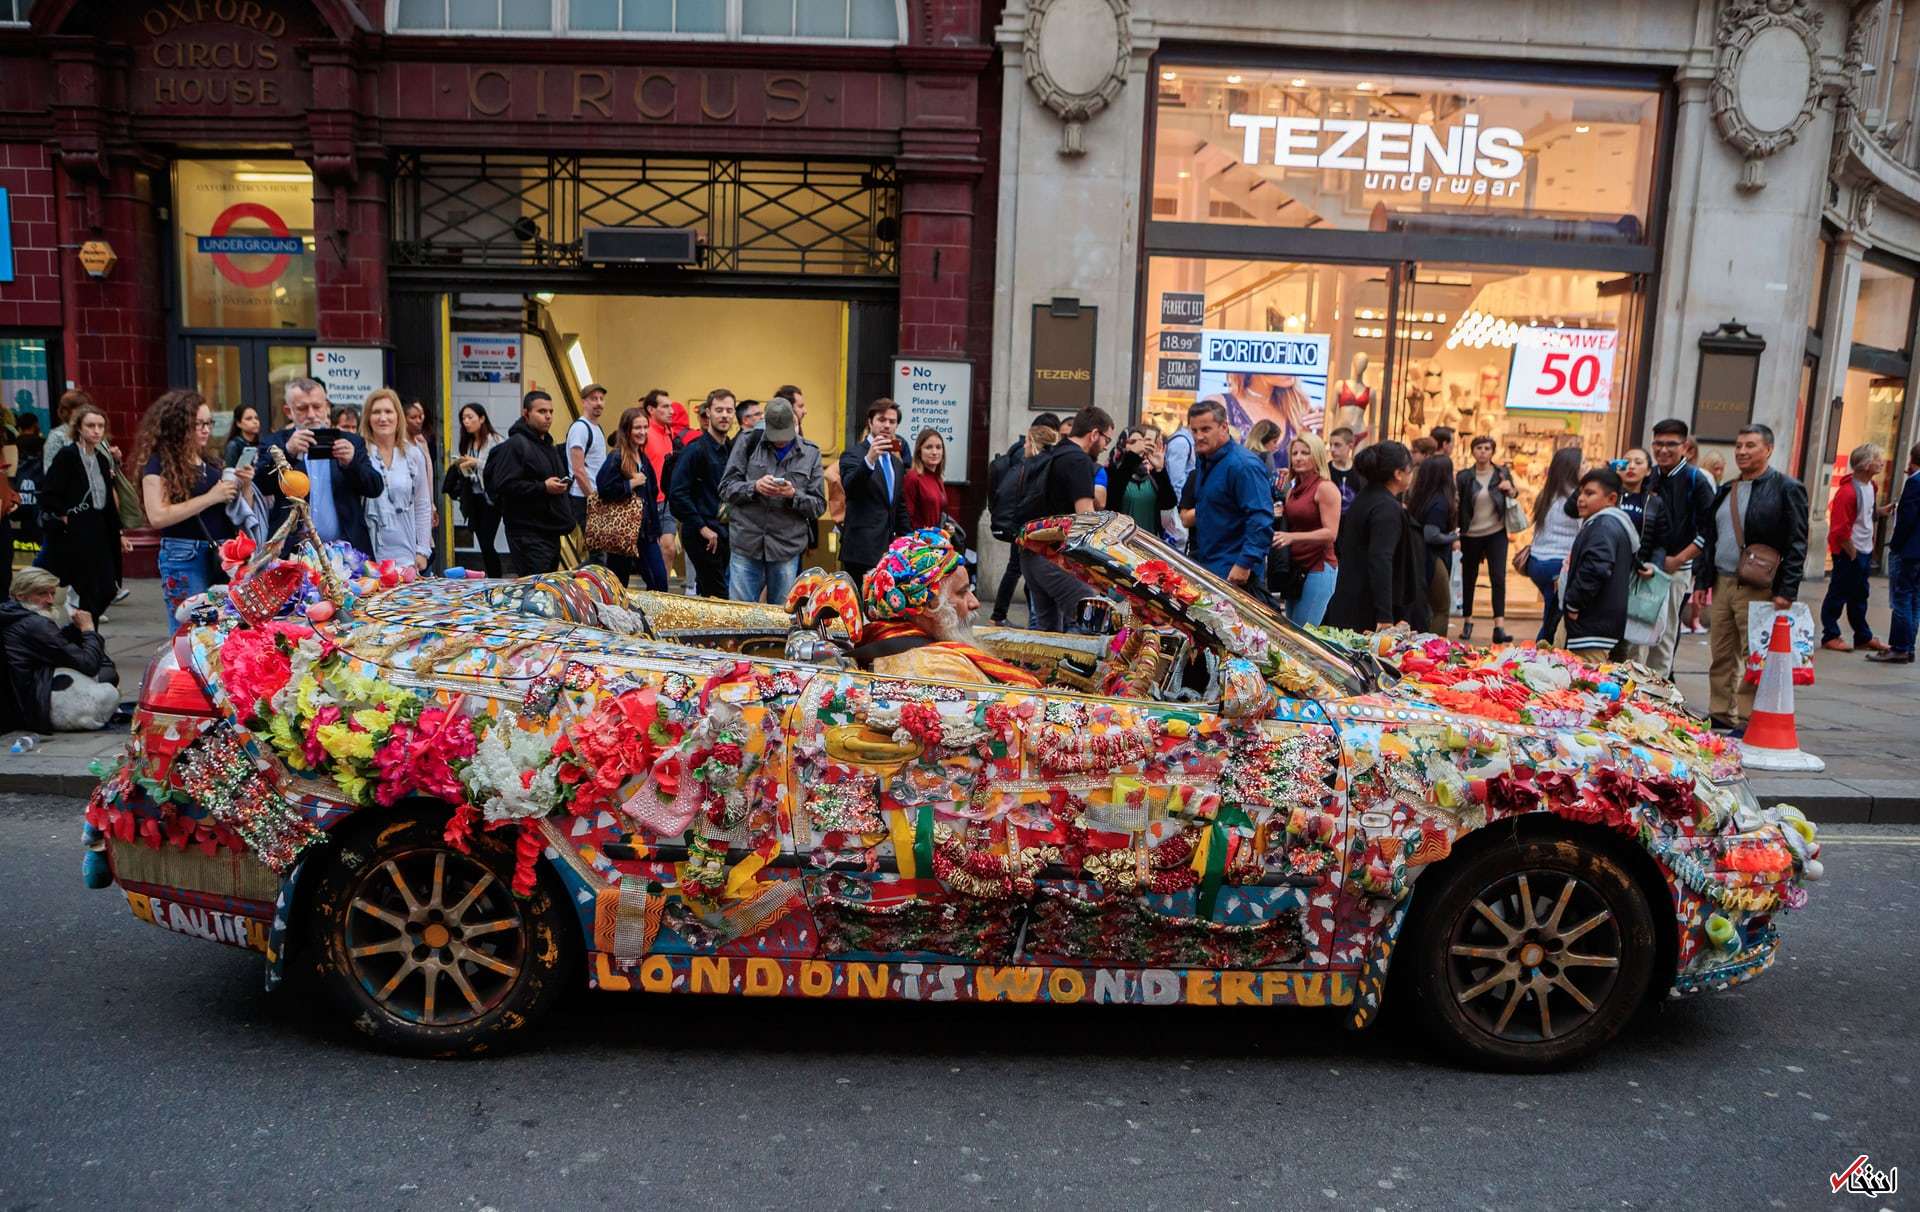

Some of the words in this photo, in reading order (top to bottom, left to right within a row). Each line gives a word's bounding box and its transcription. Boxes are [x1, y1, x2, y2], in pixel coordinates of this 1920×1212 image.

[144, 0, 286, 38] OXFORD
[153, 42, 279, 69] CIRCUS
[154, 78, 279, 104] HOUSE
[468, 67, 809, 122] CIRCUS
[1364, 173, 1521, 197] underwear
[203, 240, 298, 251] UNDERGROUND
[1163, 300, 1191, 316] PERFECT
[328, 352, 346, 363] No
[1210, 338, 1318, 366] PORTOFINO
[328, 368, 361, 379] entry
[913, 366, 932, 377] No
[1168, 361, 1187, 374] EXTRA
[1167, 374, 1196, 387] COMFORT
[1536, 353, 1600, 397] 50
[329, 383, 354, 391] Please
[912, 382, 946, 394] entry
[912, 396, 940, 406] Please
[911, 407, 949, 415] entrance
[924, 425, 953, 433] Oford
[595, 952, 889, 998] LONDON
[900, 962, 965, 1001] IS
[975, 967, 1355, 1006] WONDERFUL
